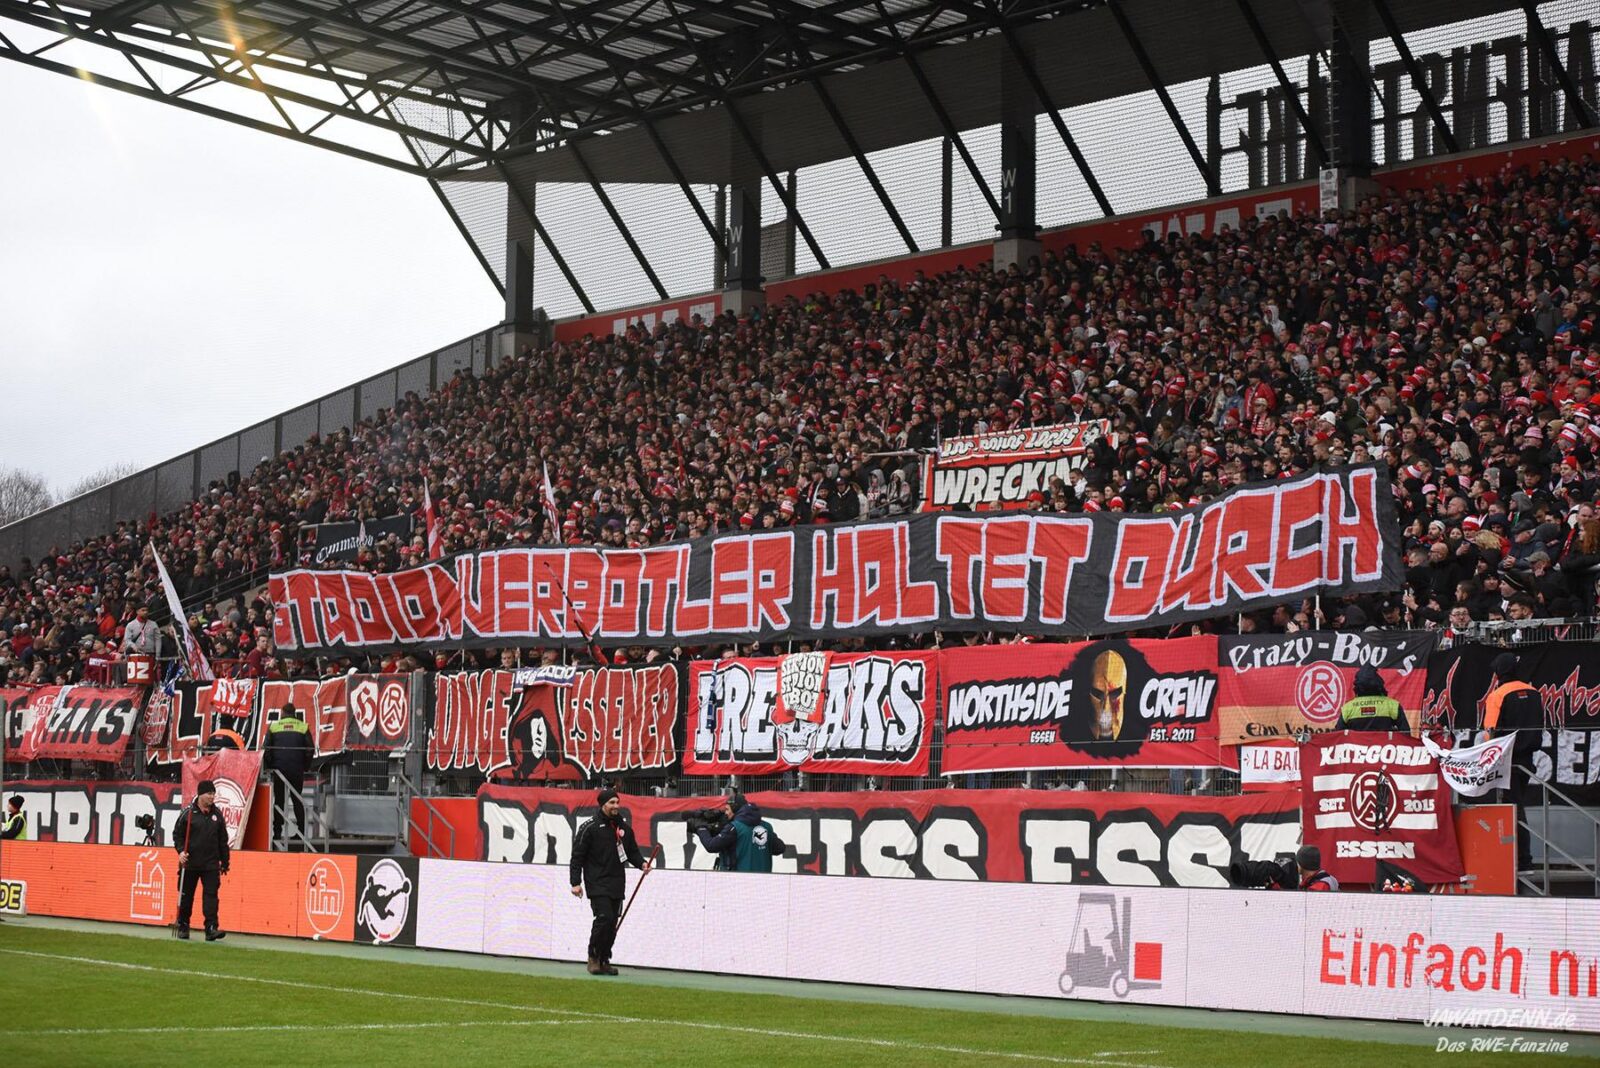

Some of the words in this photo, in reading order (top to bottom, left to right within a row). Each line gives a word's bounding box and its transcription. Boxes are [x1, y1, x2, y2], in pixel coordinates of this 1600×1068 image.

[1104, 468, 1383, 623] DURCH
[947, 679, 1073, 729] NORTHSIDE
[1139, 676, 1216, 718] CREW
[427, 669, 514, 772] JUNGE
[562, 663, 679, 773] ESSENER
[1030, 731, 1056, 743] ESSEN
[1150, 729, 1169, 742] EST.
[1171, 728, 1195, 742] 2011
[1253, 750, 1269, 769] LA
[1273, 751, 1300, 770] BAN
[1320, 743, 1431, 766] KATEGORIE
[1451, 770, 1503, 787] MARCEL
[1403, 799, 1435, 813] 2015
[1336, 841, 1415, 859] ESSEN
[1320, 928, 1523, 995] Einfach
